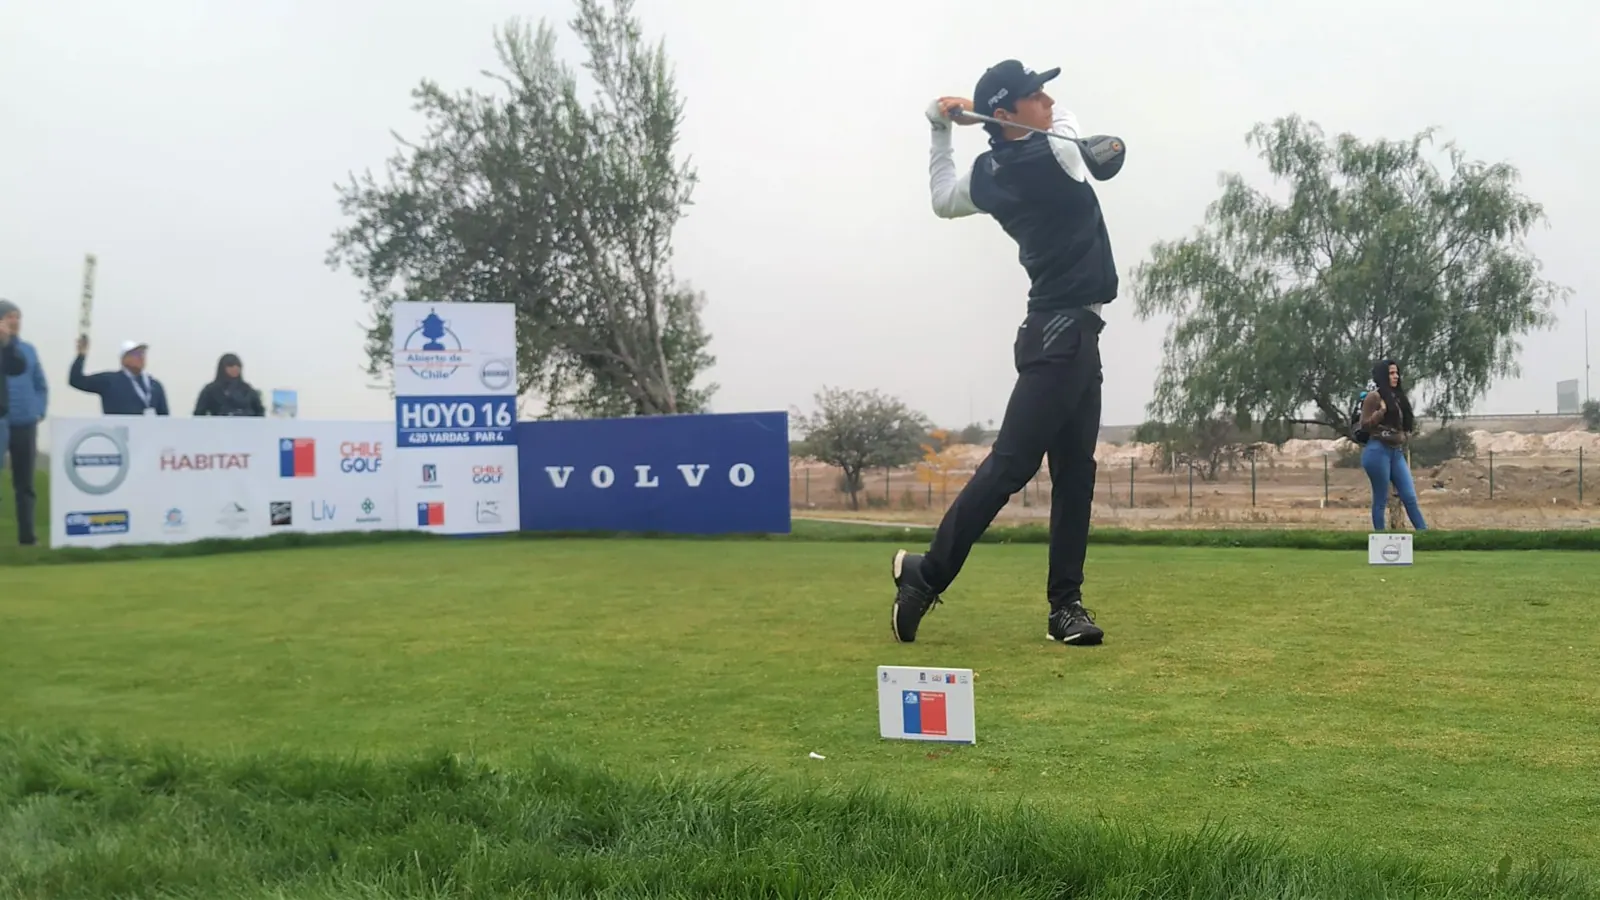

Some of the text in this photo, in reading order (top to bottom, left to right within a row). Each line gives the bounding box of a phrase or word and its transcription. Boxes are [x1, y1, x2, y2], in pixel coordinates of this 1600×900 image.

[420, 370, 450, 380] Chile
[402, 402, 512, 428] HOYO 16
[408, 432, 504, 443] 420 YARDAS PAR 4
[340, 441, 382, 457] CHILE
[160, 453, 251, 471] HABITAT
[341, 457, 382, 473] GOLF
[545, 463, 755, 488] VOLVO
